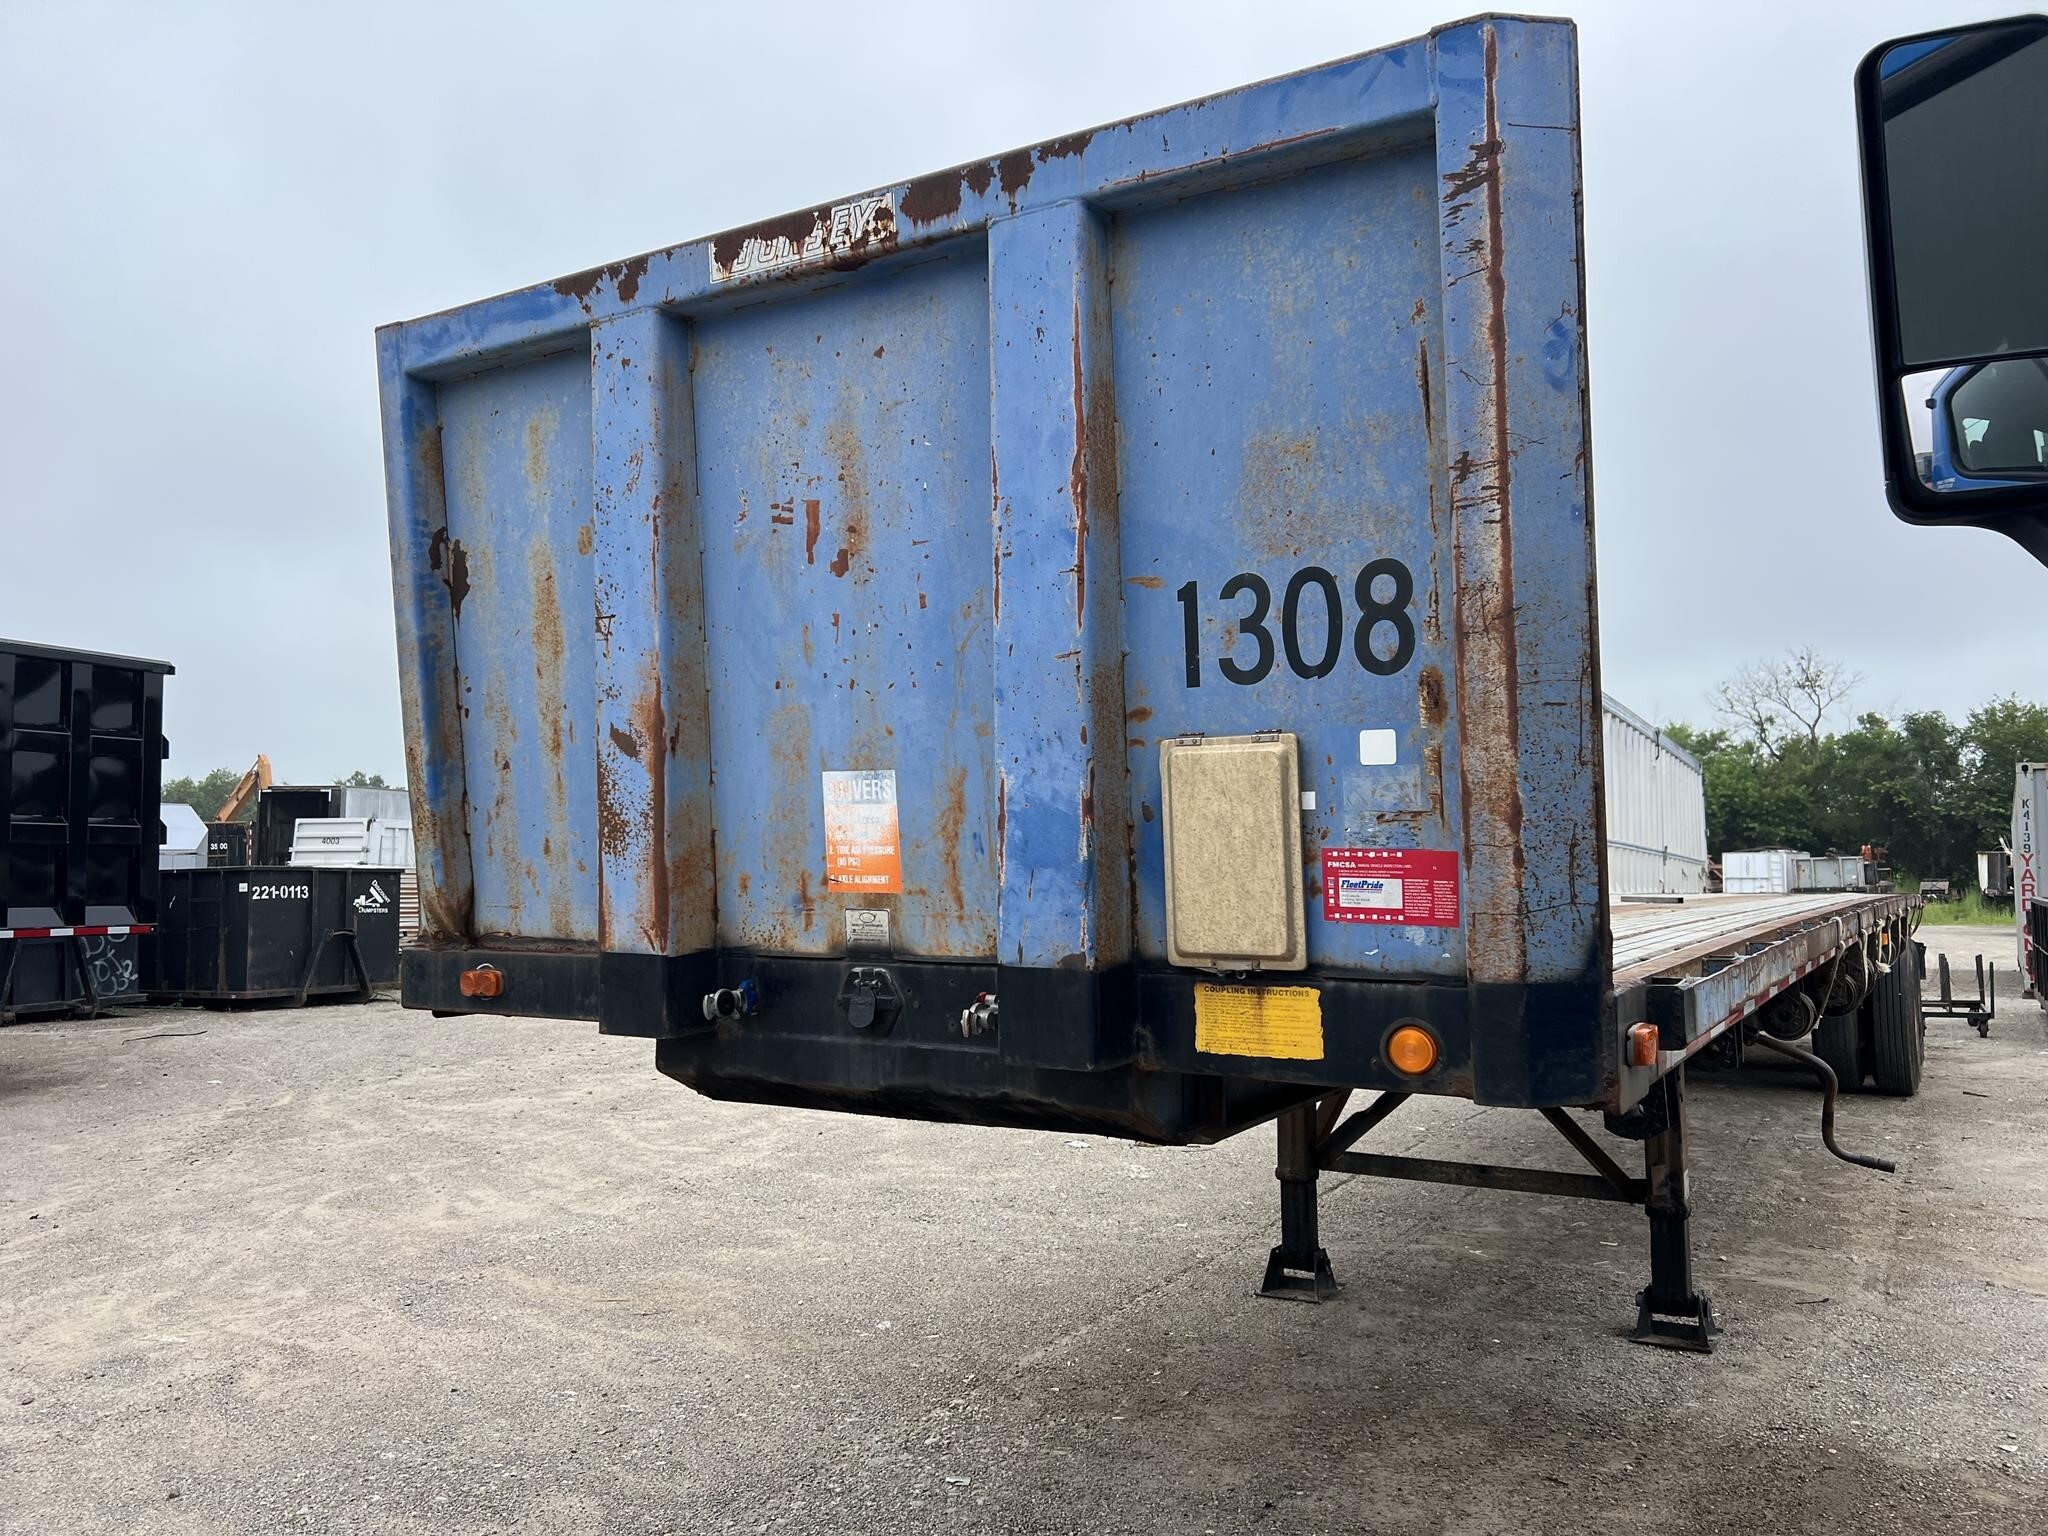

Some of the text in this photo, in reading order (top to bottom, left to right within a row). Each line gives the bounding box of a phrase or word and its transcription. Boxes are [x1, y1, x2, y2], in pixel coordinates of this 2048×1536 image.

[1176, 557, 1416, 689] 1308
[2022, 798, 2031, 854] K4139
[321, 836, 340, 845] 4003
[1327, 861, 1357, 869] FMCSA
[838, 874, 854, 884] AXLE
[854, 874, 889, 885] ALIGNMENT
[1340, 879, 1384, 889] FleetPride
[251, 884, 309, 900] 221-0113
[358, 906, 389, 914] DUMPSTERS
[1204, 985, 1310, 998] COUPLING INSTRUCTIONS
